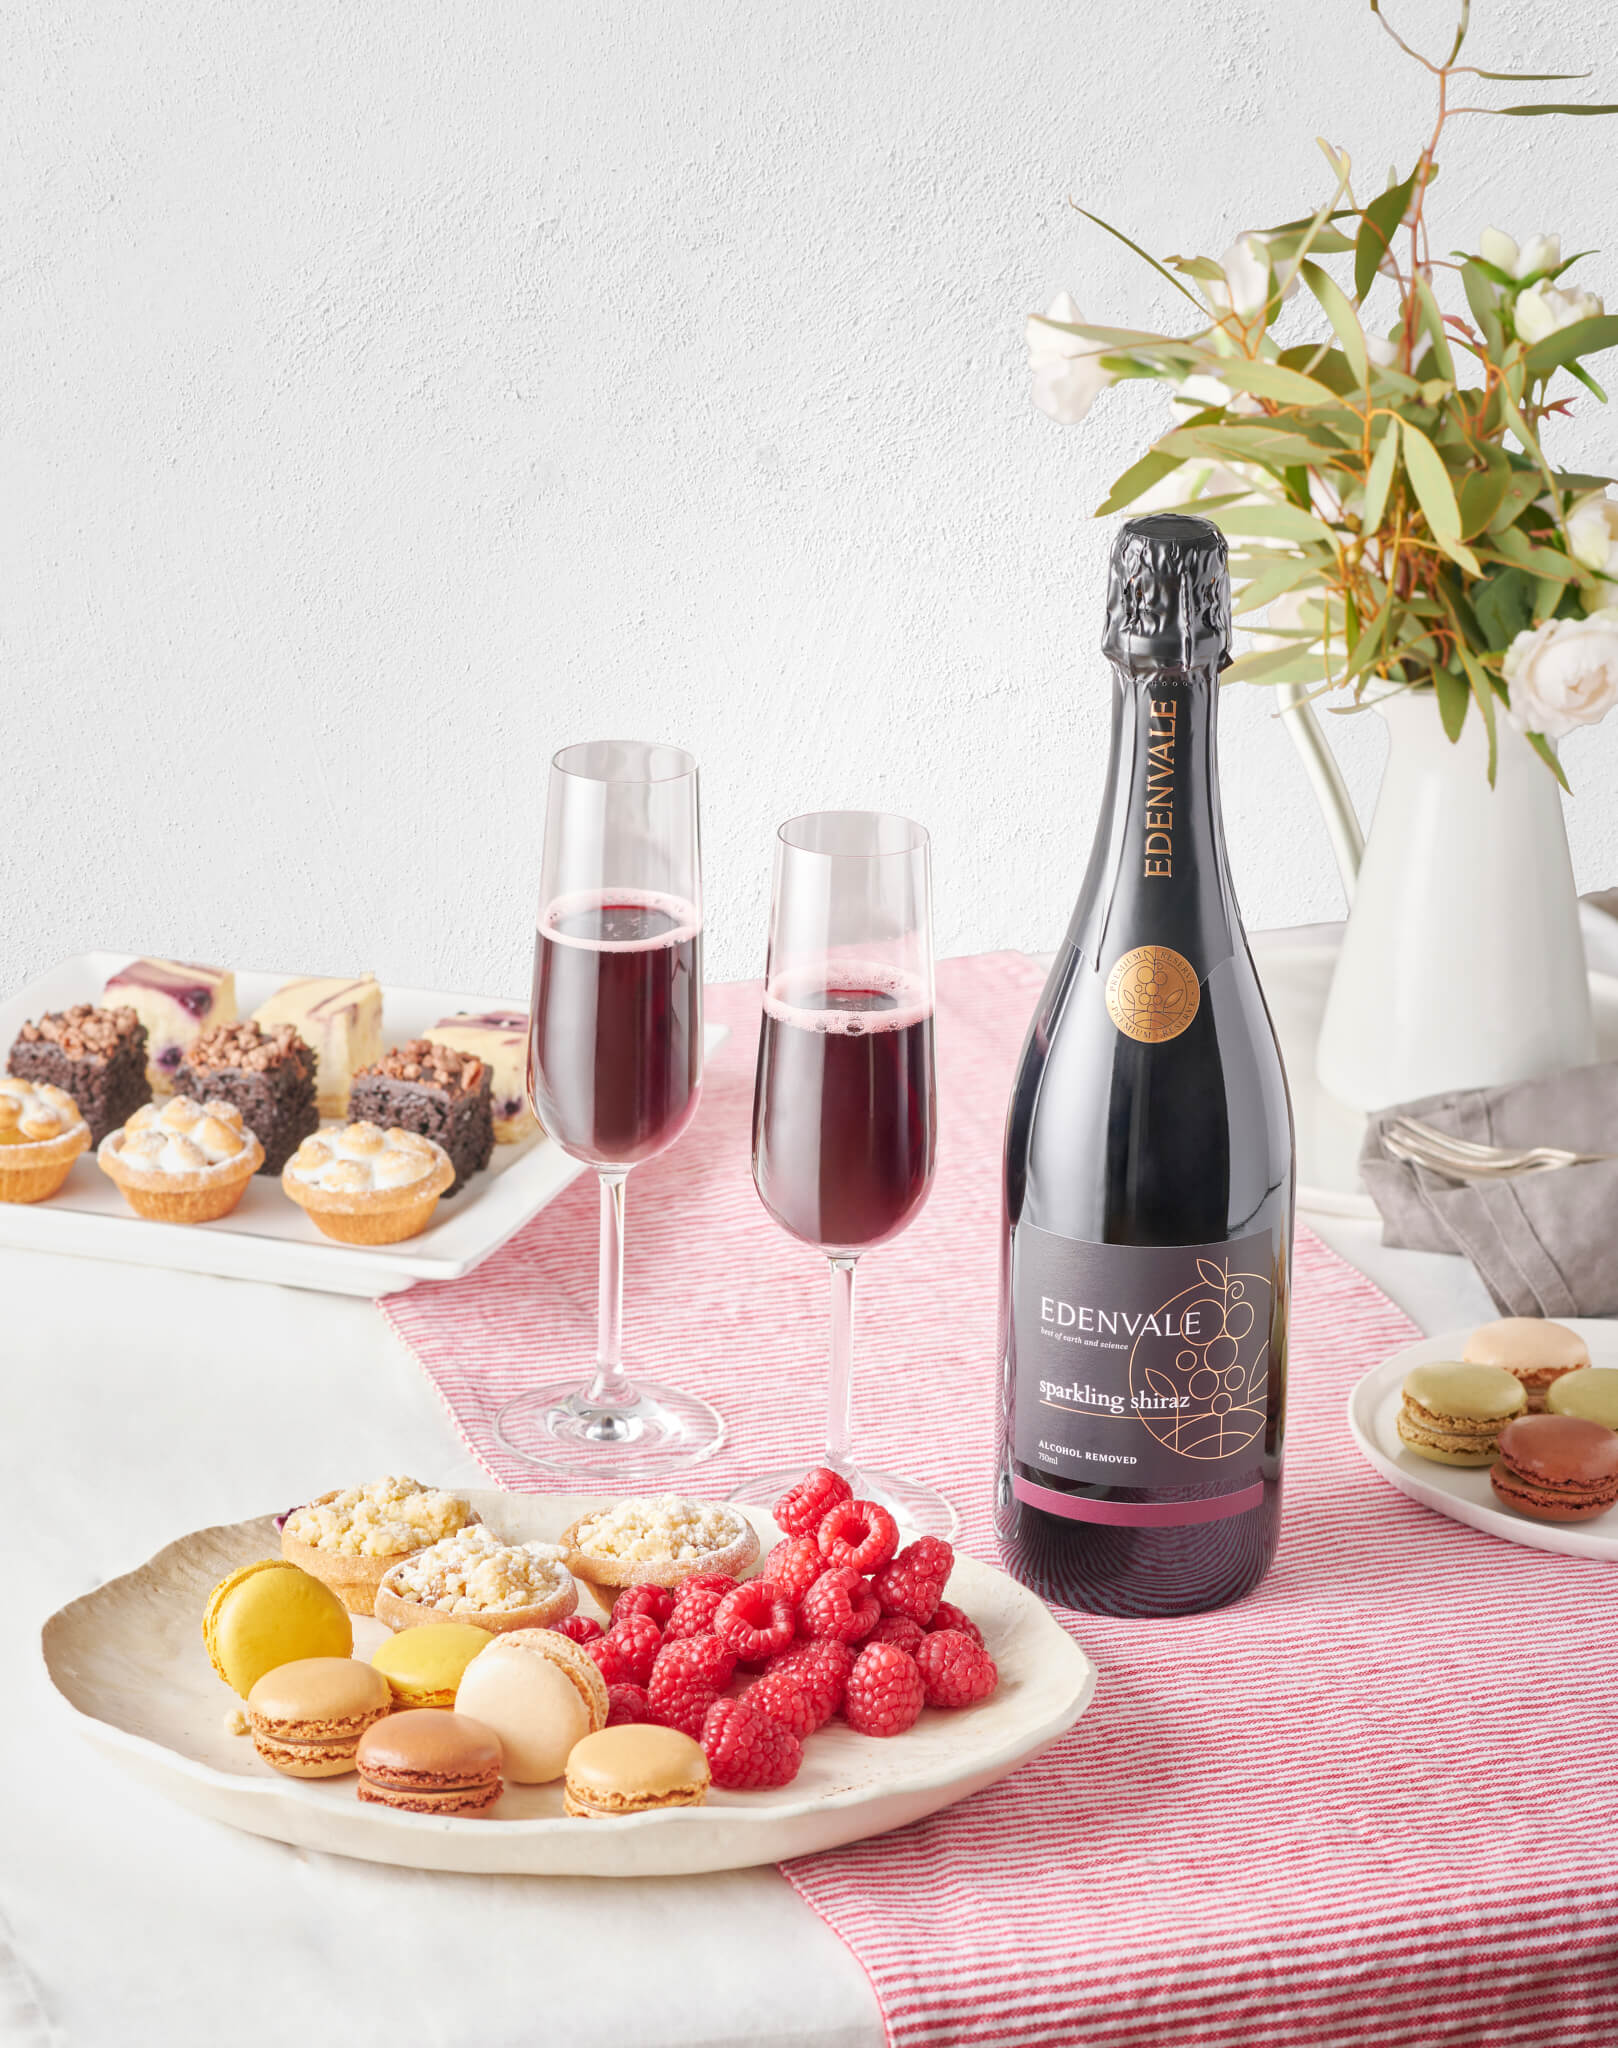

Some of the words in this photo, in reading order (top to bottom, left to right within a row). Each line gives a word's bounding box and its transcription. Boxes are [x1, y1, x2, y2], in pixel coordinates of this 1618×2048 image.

[1144, 699, 1178, 878] EDENVALE
[1110, 952, 1142, 992] PREMIUM
[1160, 951, 1195, 984] RESERVE
[1111, 1004, 1152, 1039] PREMIUM
[1161, 1001, 1196, 1038] RESERVE
[1040, 1295, 1202, 1337] EDENVALE
[1040, 1326, 1054, 1337] best
[1054, 1332, 1063, 1341] of
[1063, 1335, 1082, 1345] earth
[1084, 1339, 1099, 1347] and
[1100, 1341, 1129, 1350] science
[1039, 1380, 1126, 1414] sparkling
[1130, 1390, 1191, 1409] shiraz
[1037, 1451, 1058, 1465] 750ml
[1038, 1439, 1082, 1459] ALCOHOL
[1085, 1451, 1138, 1465] REMOVED
